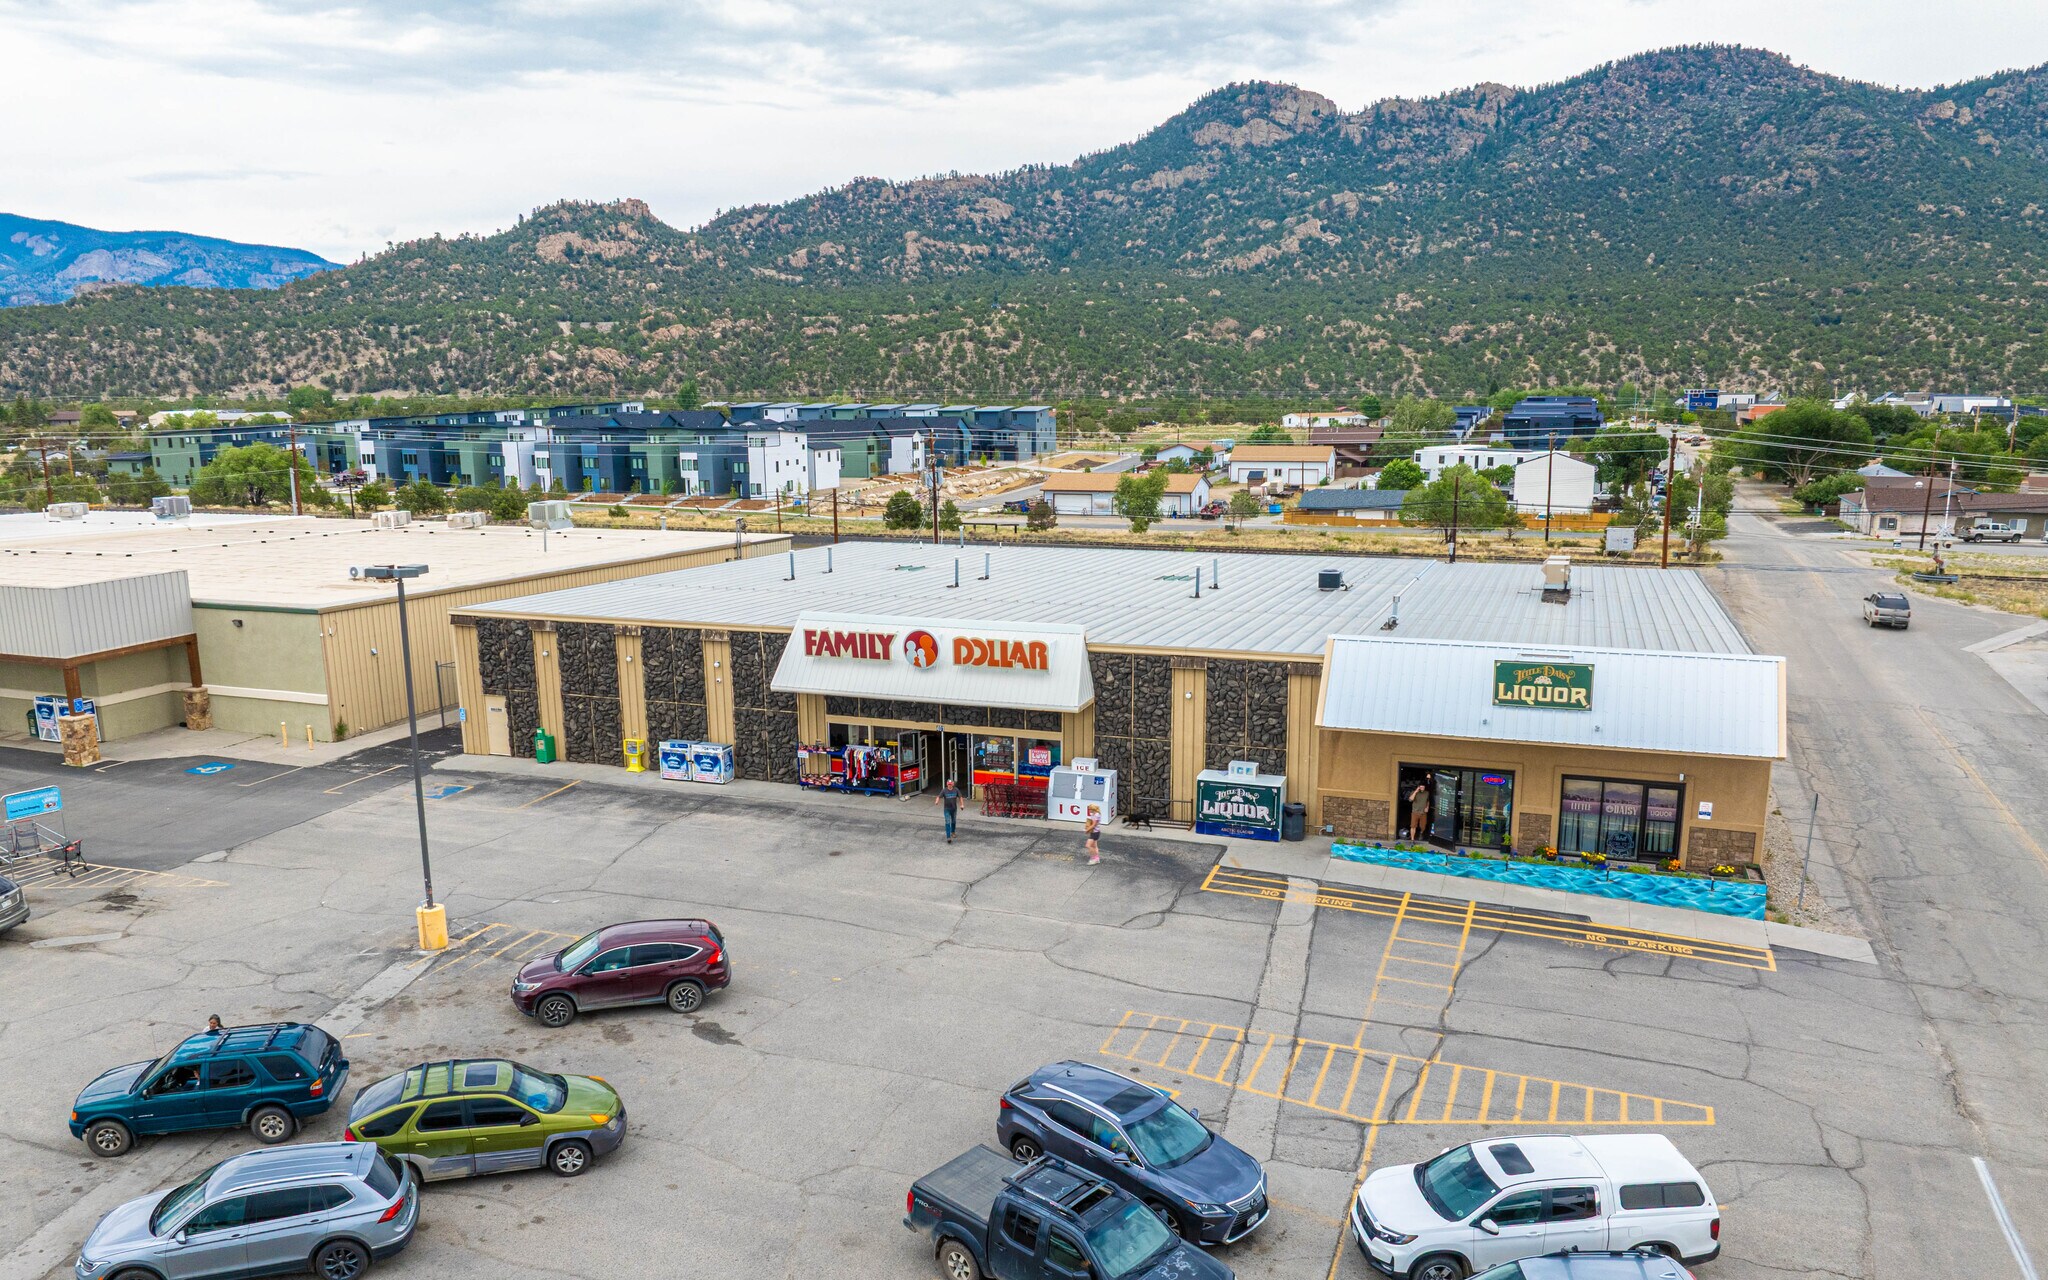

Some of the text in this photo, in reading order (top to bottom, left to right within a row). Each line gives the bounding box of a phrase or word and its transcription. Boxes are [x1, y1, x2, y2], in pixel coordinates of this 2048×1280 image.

[803, 629, 1049, 671] FAMILY DOLLAR
[1497, 682, 1590, 709] LIQUOR
[1200, 800, 1273, 822] LIQUOR
[1570, 802, 1592, 811] LITTLE
[1614, 805, 1639, 816] DAISY
[1650, 810, 1673, 818] LIQUOR
[1260, 889, 1280, 897] NO
[1585, 934, 1607, 943] NO
[1627, 940, 1694, 954] PARKING
